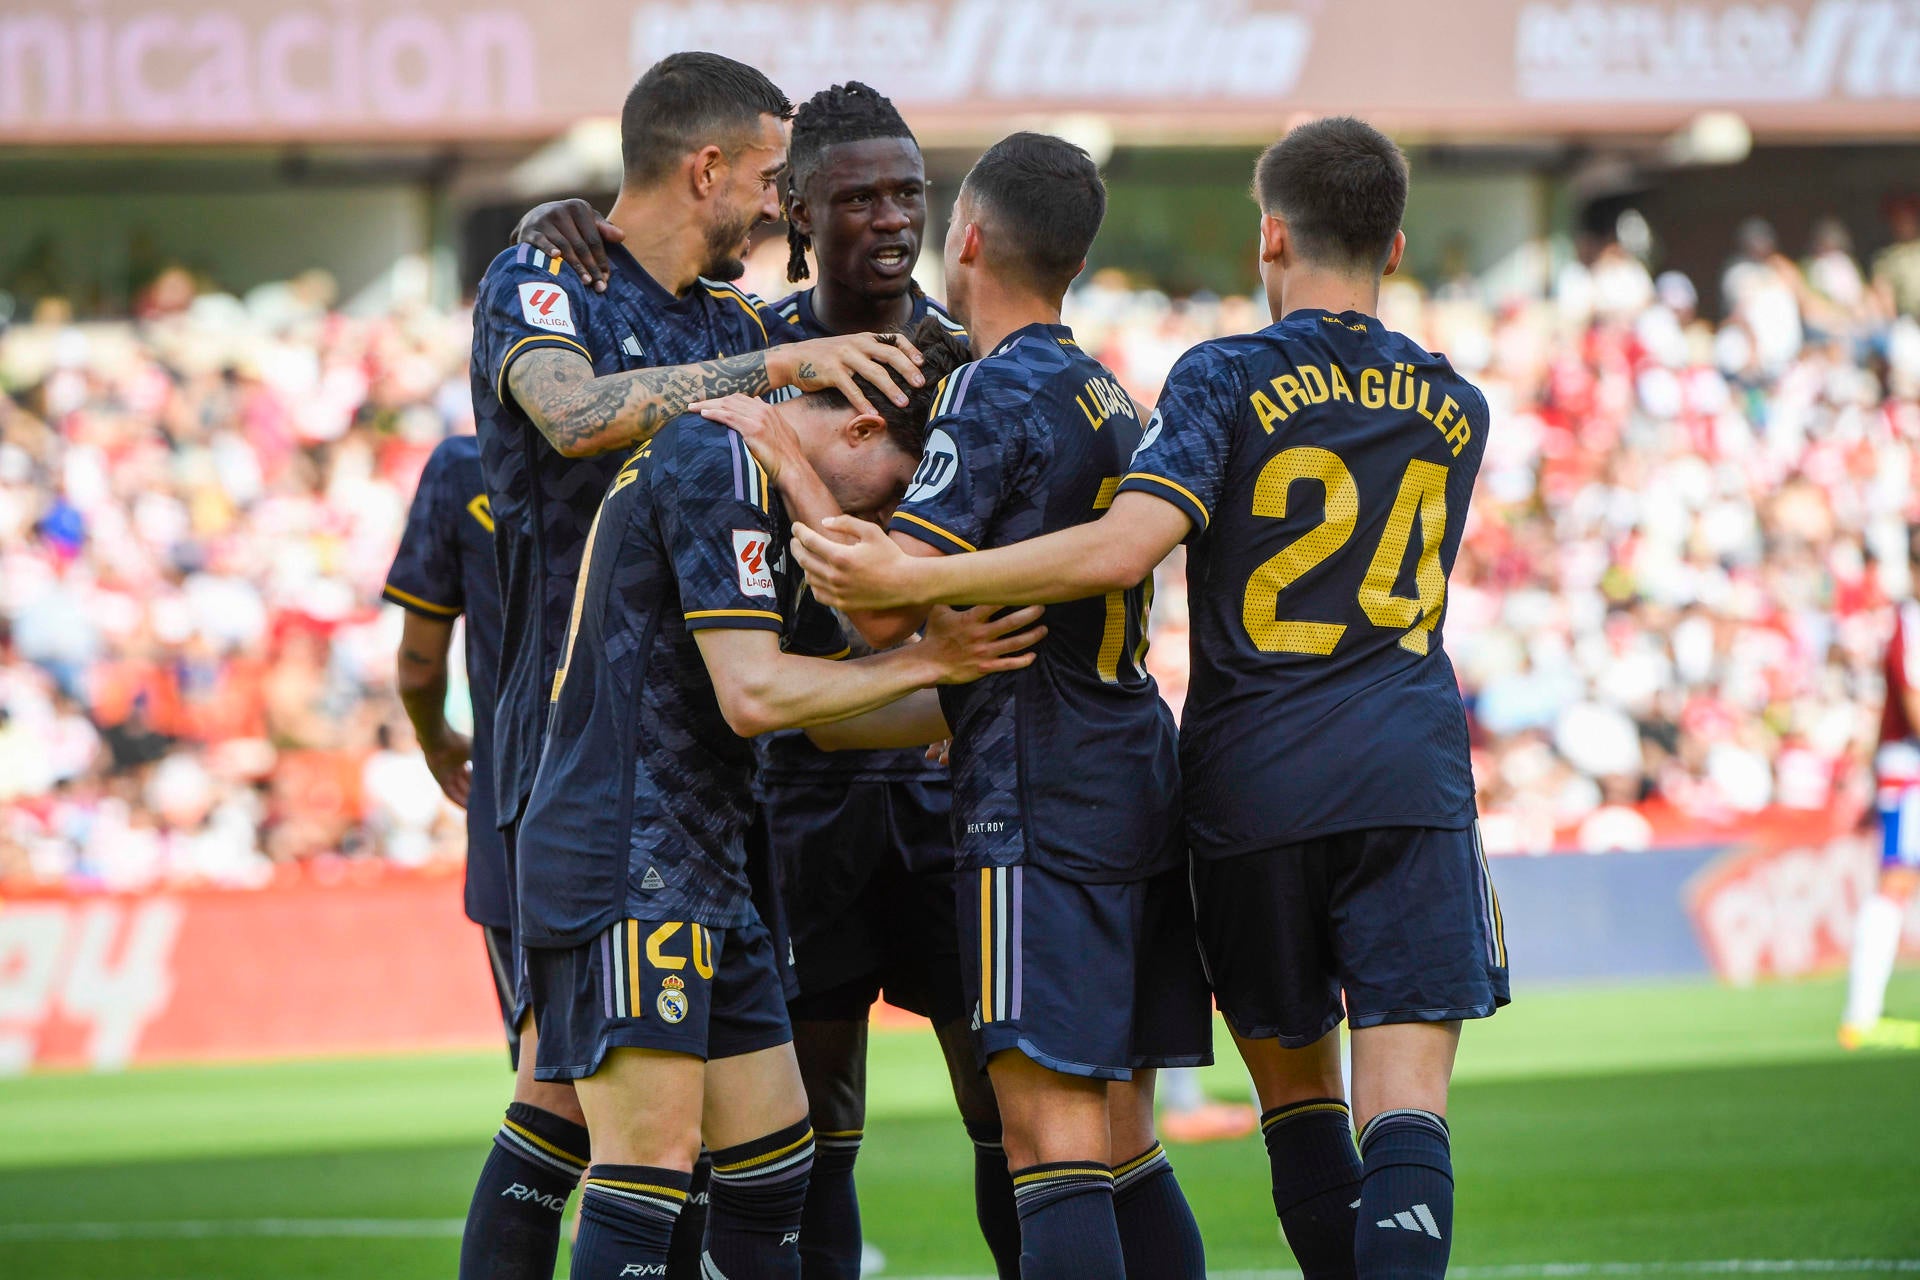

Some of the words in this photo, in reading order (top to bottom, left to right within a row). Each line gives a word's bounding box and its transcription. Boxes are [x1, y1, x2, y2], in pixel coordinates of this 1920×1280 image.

[532, 317, 569, 328] LALIGA
[1075, 376, 1134, 431] LUCAS
[1250, 363, 1354, 435] ARDA
[1360, 362, 1472, 457] GÜLER
[1242, 445, 1449, 657] 24
[967, 821, 1004, 834] HEAT.RDY
